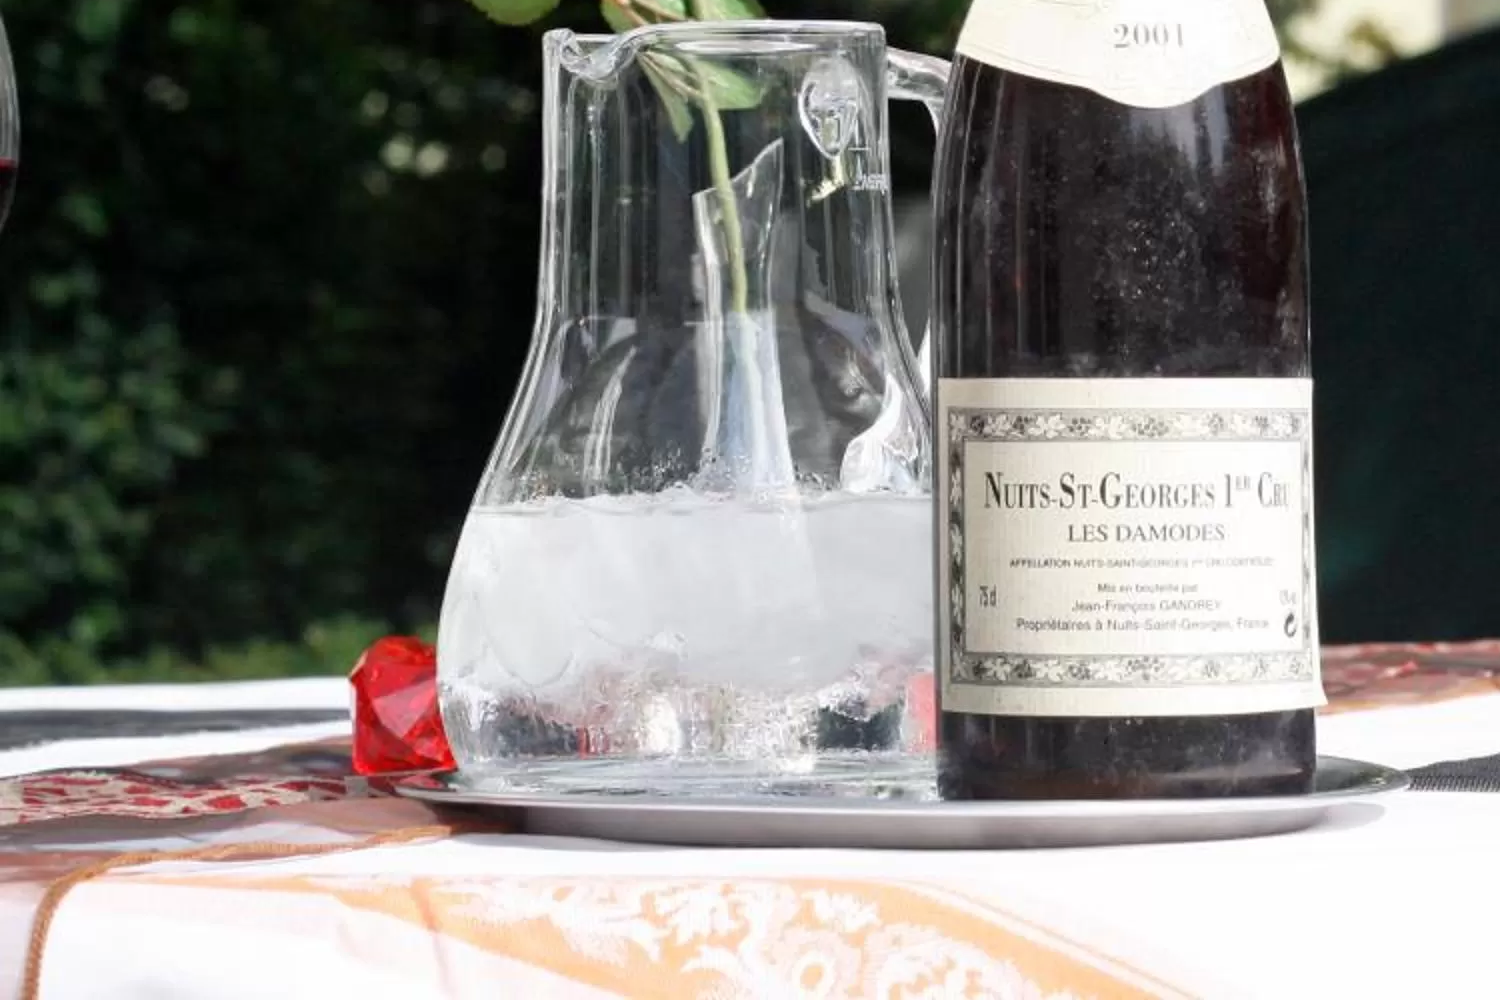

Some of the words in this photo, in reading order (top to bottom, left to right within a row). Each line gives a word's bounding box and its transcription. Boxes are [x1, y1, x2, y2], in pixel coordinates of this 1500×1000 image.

[1112, 22, 1183, 49] 2001
[1067, 523, 1108, 544] LES
[1115, 522, 1226, 543] DAMODES
